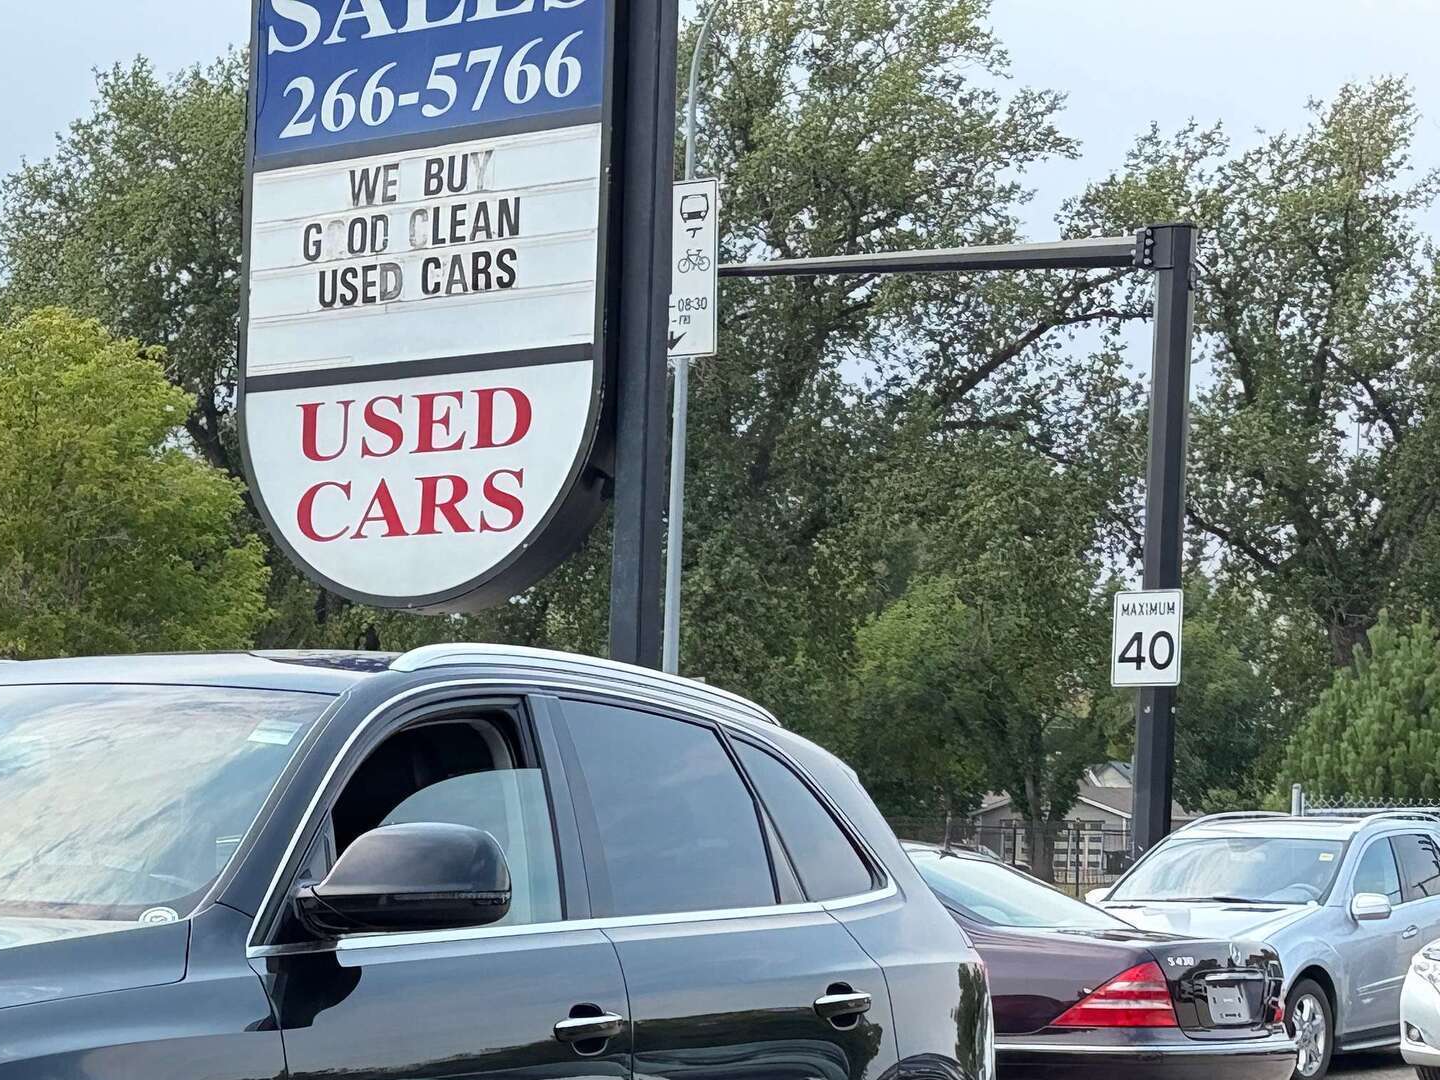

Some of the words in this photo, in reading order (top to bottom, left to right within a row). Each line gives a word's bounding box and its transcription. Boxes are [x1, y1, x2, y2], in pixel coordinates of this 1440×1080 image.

[267, 0, 587, 55] SAL
[278, 30, 584, 139] 266-5766
[349, 163, 400, 207] WE
[423, 149, 495, 196] BUY
[409, 197, 521, 248] CLEAN
[318, 262, 404, 308] USED
[421, 248, 518, 295] CARS
[296, 387, 532, 461] USED
[296, 468, 525, 543] CARS
[1121, 601, 1175, 616] MAXIMUM
[1117, 630, 1175, 671] 40
